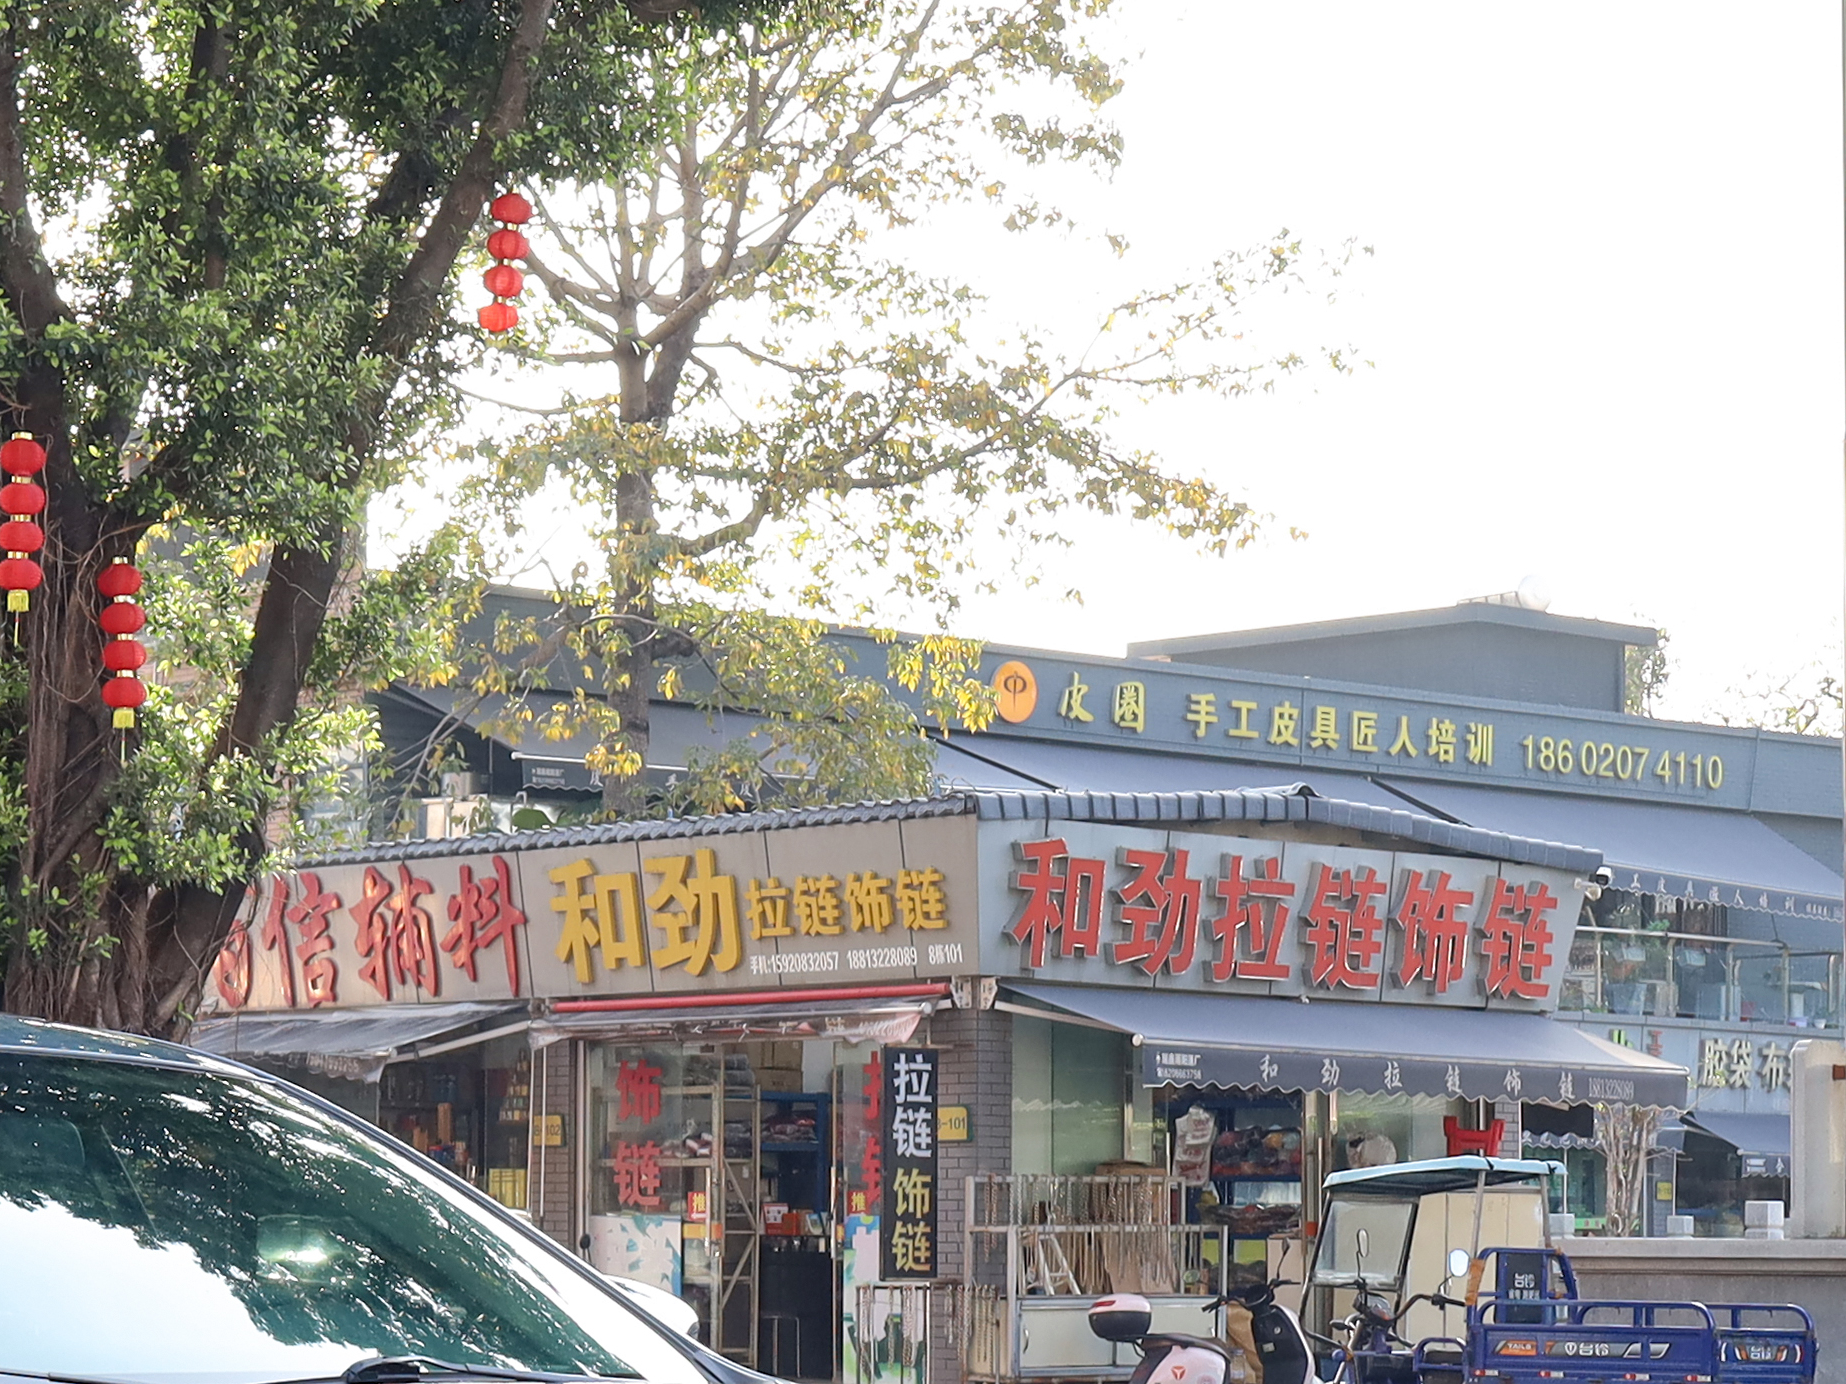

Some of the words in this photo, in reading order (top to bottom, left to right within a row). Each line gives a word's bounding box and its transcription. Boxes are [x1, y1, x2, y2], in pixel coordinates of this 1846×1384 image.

[1186, 692, 1495, 767] 手工皮具匠人培训
[547, 847, 742, 984] 和劲
[744, 865, 948, 940] 拉链饰链
[846, 946, 918, 970] 18813228089
[1006, 837, 1559, 1000] 和劲拉链饰链
